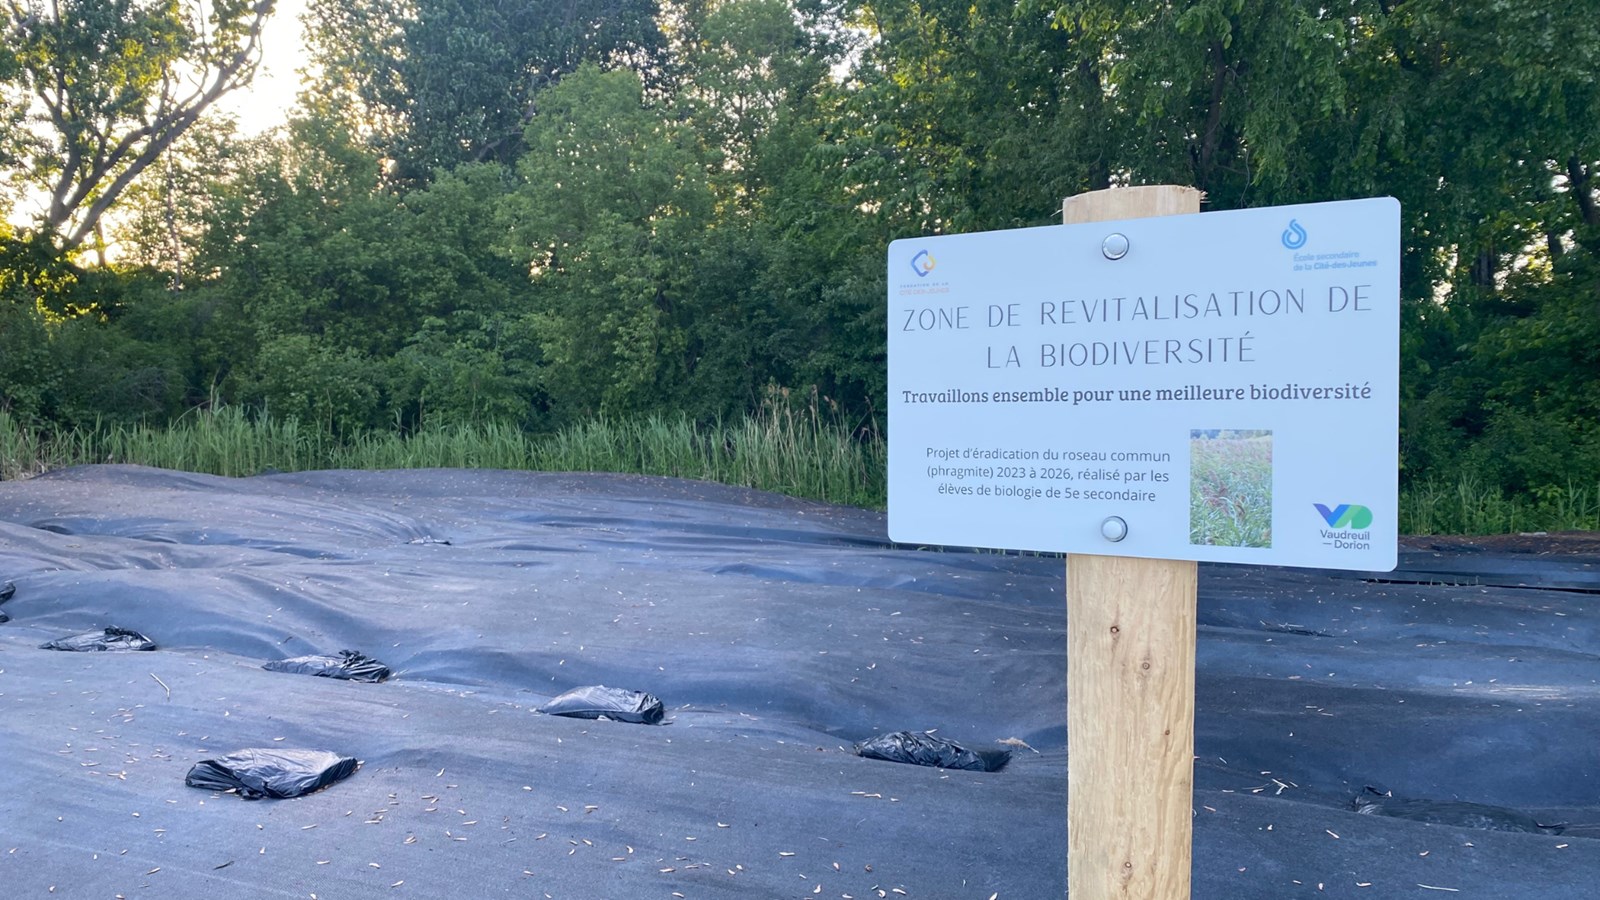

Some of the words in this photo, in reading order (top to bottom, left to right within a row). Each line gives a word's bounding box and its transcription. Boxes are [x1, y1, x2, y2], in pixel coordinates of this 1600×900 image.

[903, 306, 970, 332] ZONE
[988, 303, 1021, 328] DE
[1040, 287, 1305, 326] REVITALISATION
[1328, 285, 1372, 313] DE
[987, 345, 1021, 369] LA
[1041, 331, 1256, 368] BIODIVERSITÉ
[902, 389, 989, 404] Travaillons
[992, 387, 1069, 403] ensemble
[1072, 389, 1114, 406] pour
[1118, 389, 1151, 402] une
[1156, 385, 1245, 401] meilleure
[1250, 382, 1372, 400] biodiversité
[926, 447, 960, 461] Projet
[1042, 448, 1059, 461] du
[1062, 451, 1107, 462] roseau
[1110, 451, 1171, 463] commun
[926, 465, 994, 479] (phragmite)
[996, 466, 1026, 479] 2023
[1029, 466, 1037, 479] à
[1040, 467, 1074, 481] 2026,
[1078, 468, 1120, 481] réalisé
[1124, 471, 1147, 484] par
[1150, 469, 1170, 483] les
[938, 483, 973, 496] élèves
[976, 483, 992, 496] de
[994, 484, 1042, 500] biologie
[1045, 486, 1061, 499] de
[1064, 487, 1080, 499] 5e
[1083, 488, 1156, 502] secondaire
[1320, 529, 1370, 540] Vaudreuil
